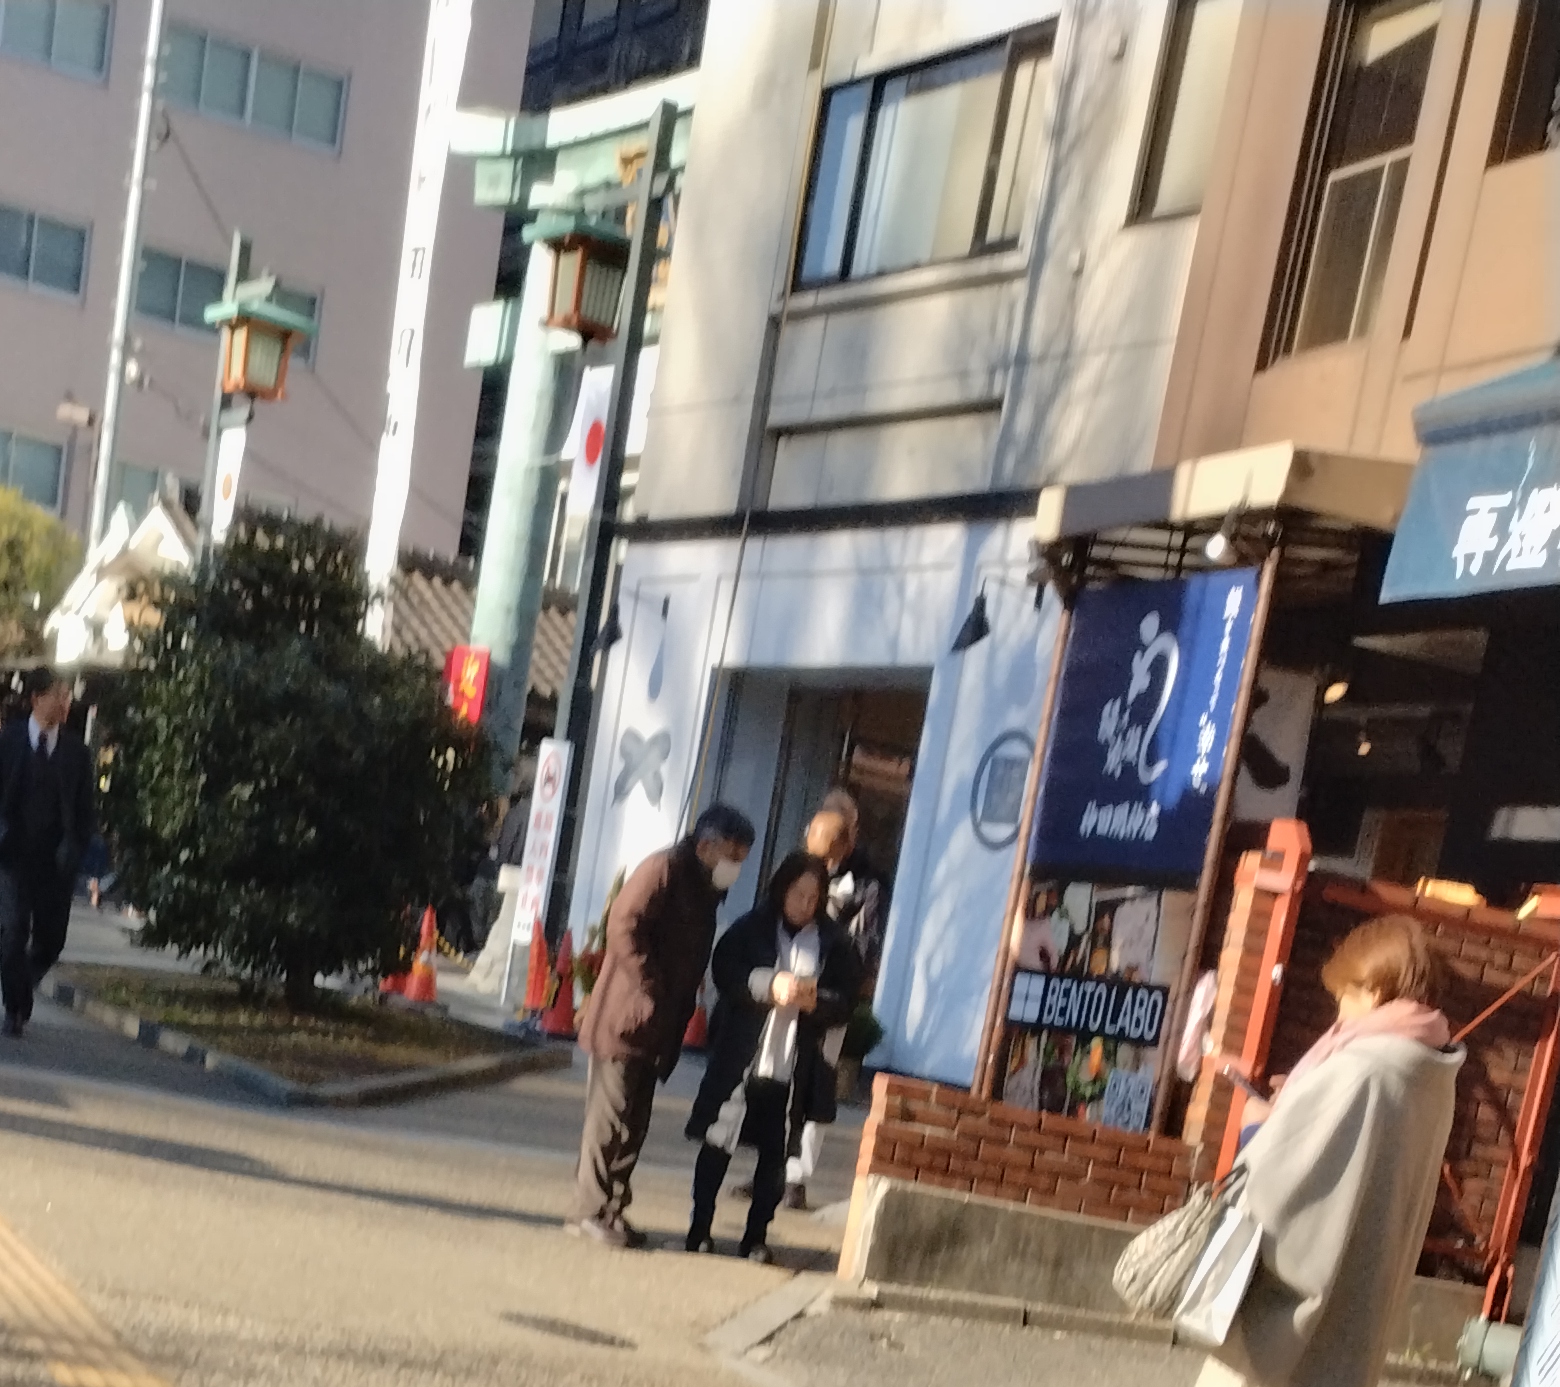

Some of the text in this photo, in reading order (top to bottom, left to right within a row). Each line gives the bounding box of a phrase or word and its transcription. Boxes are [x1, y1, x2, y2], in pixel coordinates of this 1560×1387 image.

[1452, 482, 1560, 580] 再燈
[1042, 977, 1164, 1042] BENTO LABO
